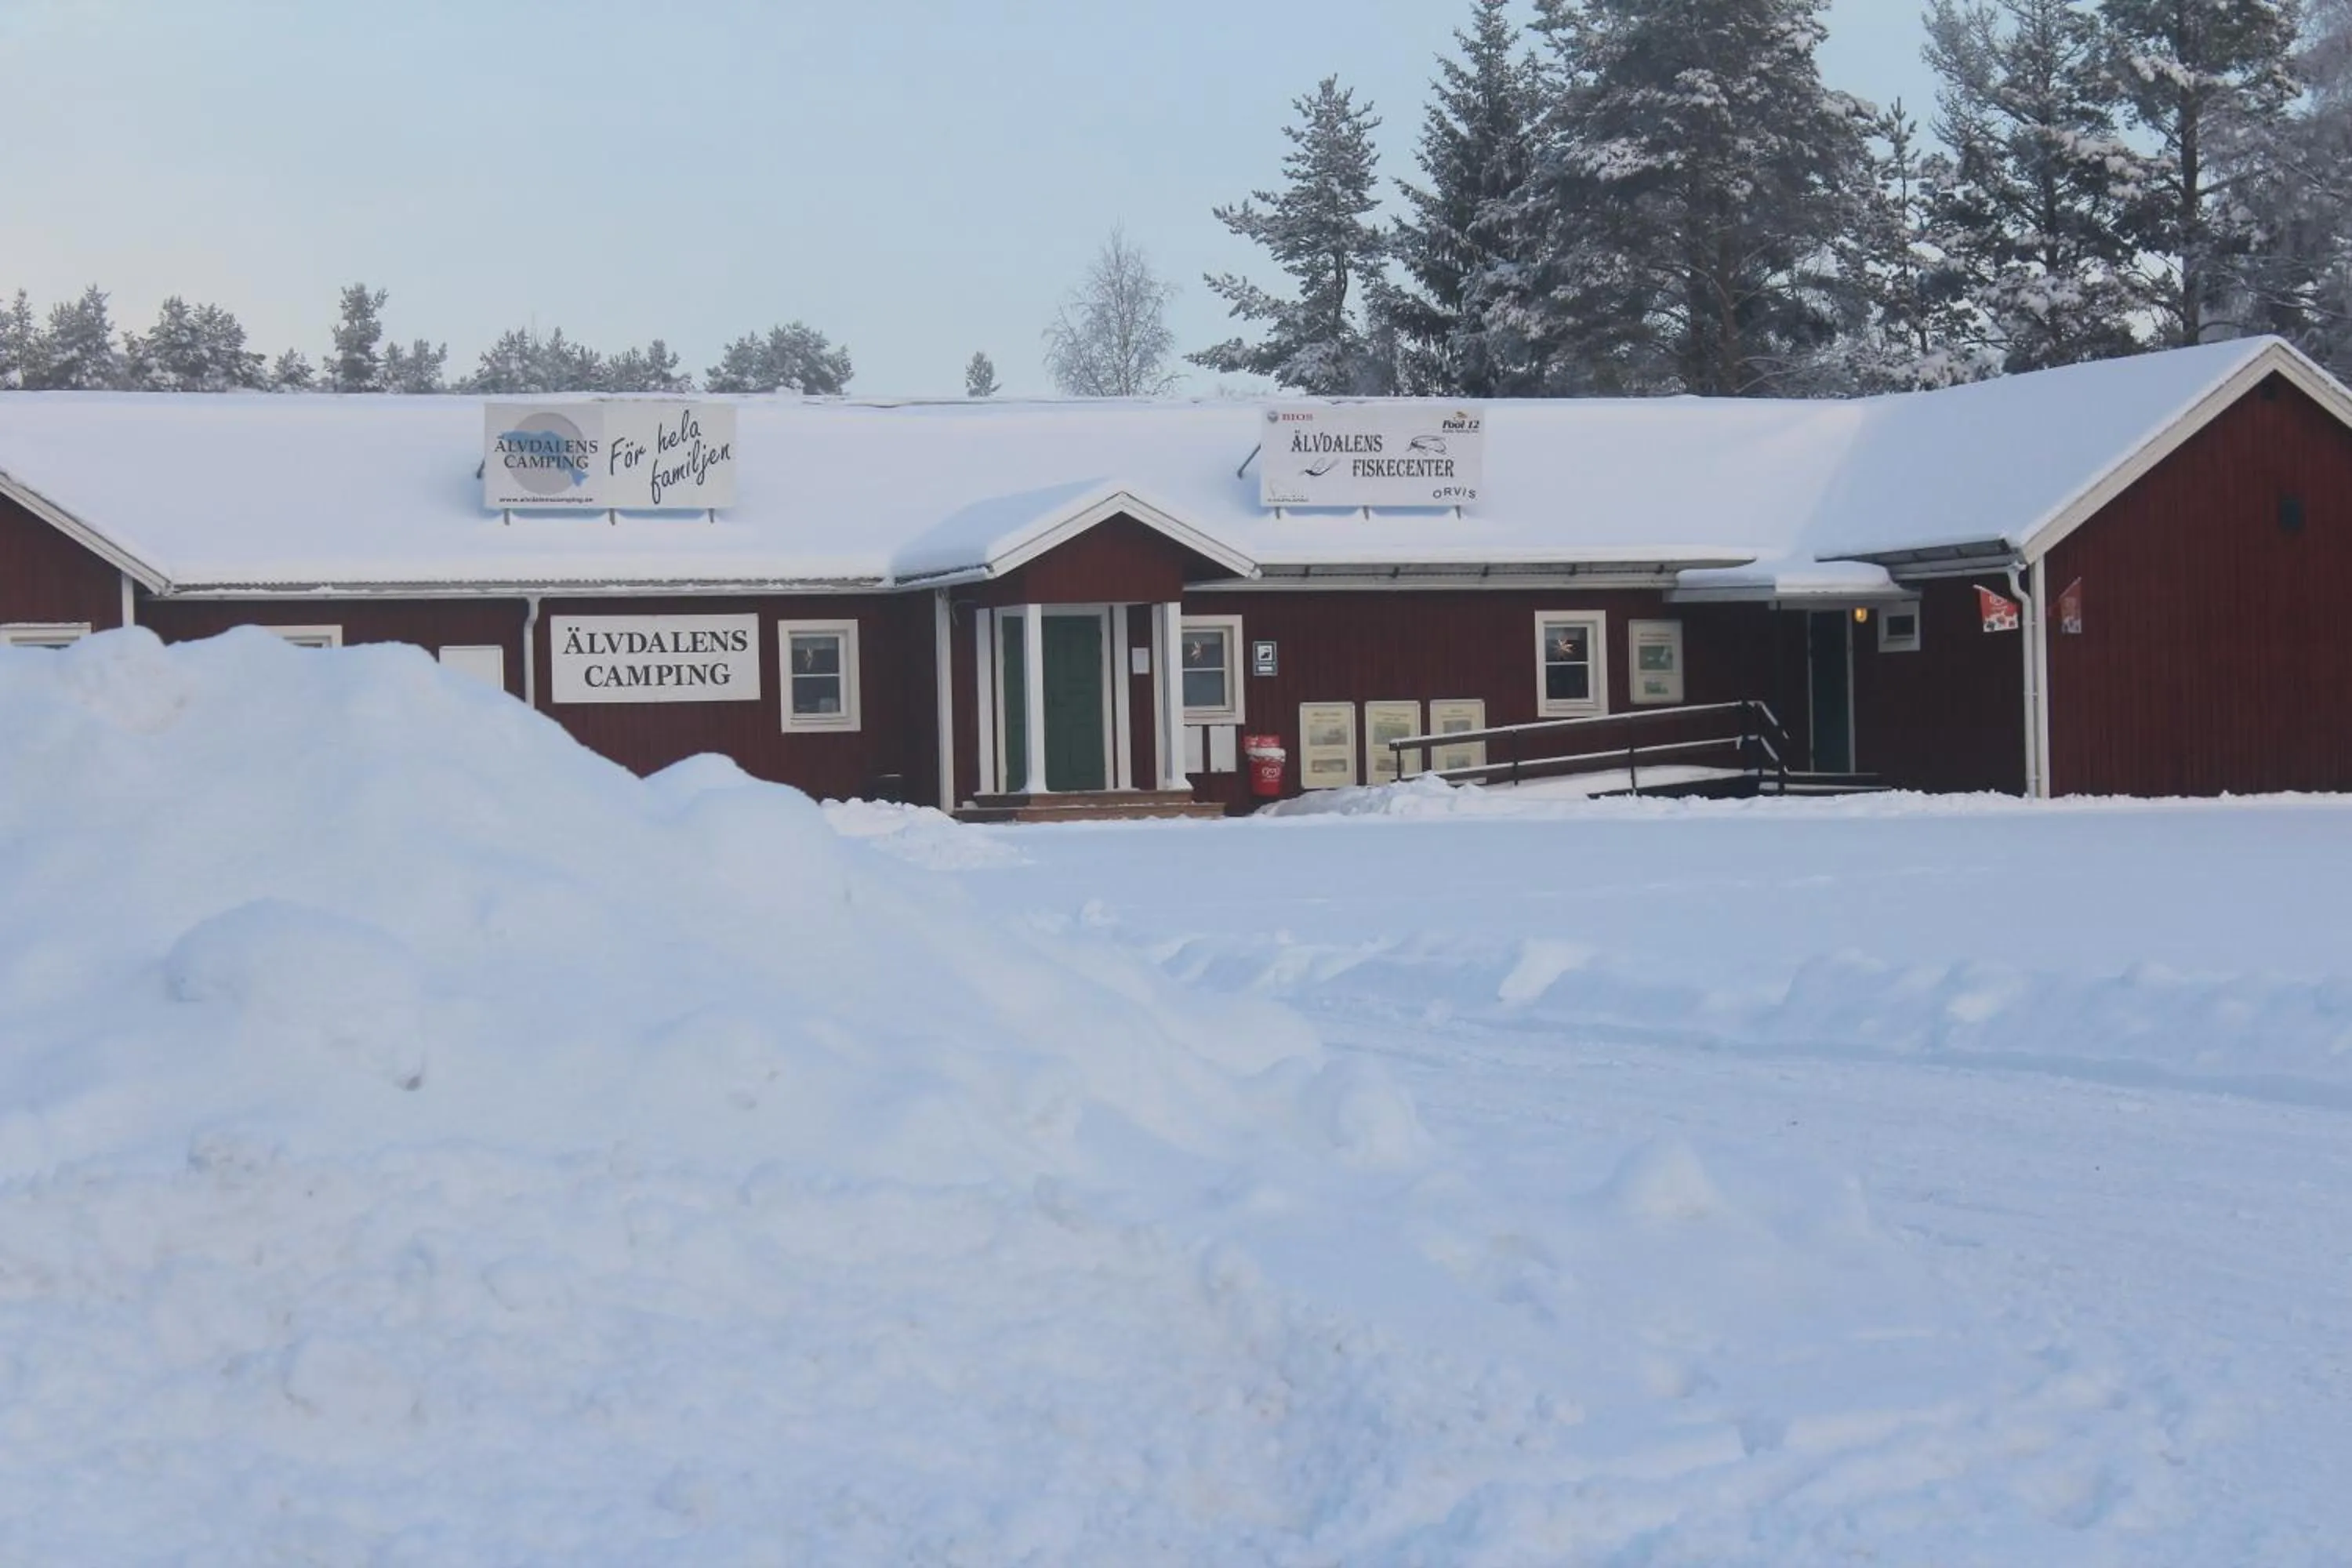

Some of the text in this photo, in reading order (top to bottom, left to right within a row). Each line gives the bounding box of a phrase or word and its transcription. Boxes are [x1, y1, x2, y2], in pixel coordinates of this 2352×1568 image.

[493, 434, 599, 454] ÄLVDALENS
[610, 409, 702, 476] För hela
[1290, 430, 1383, 453] ÄLVDALENS
[503, 453, 590, 470] CAMPING
[650, 438, 731, 505] familjen
[1352, 458, 1454, 477] FISKECENTER
[1432, 486, 1477, 500] ORVIS
[563, 626, 749, 655] ÄLVDALENS
[583, 662, 731, 688] CAMPING
